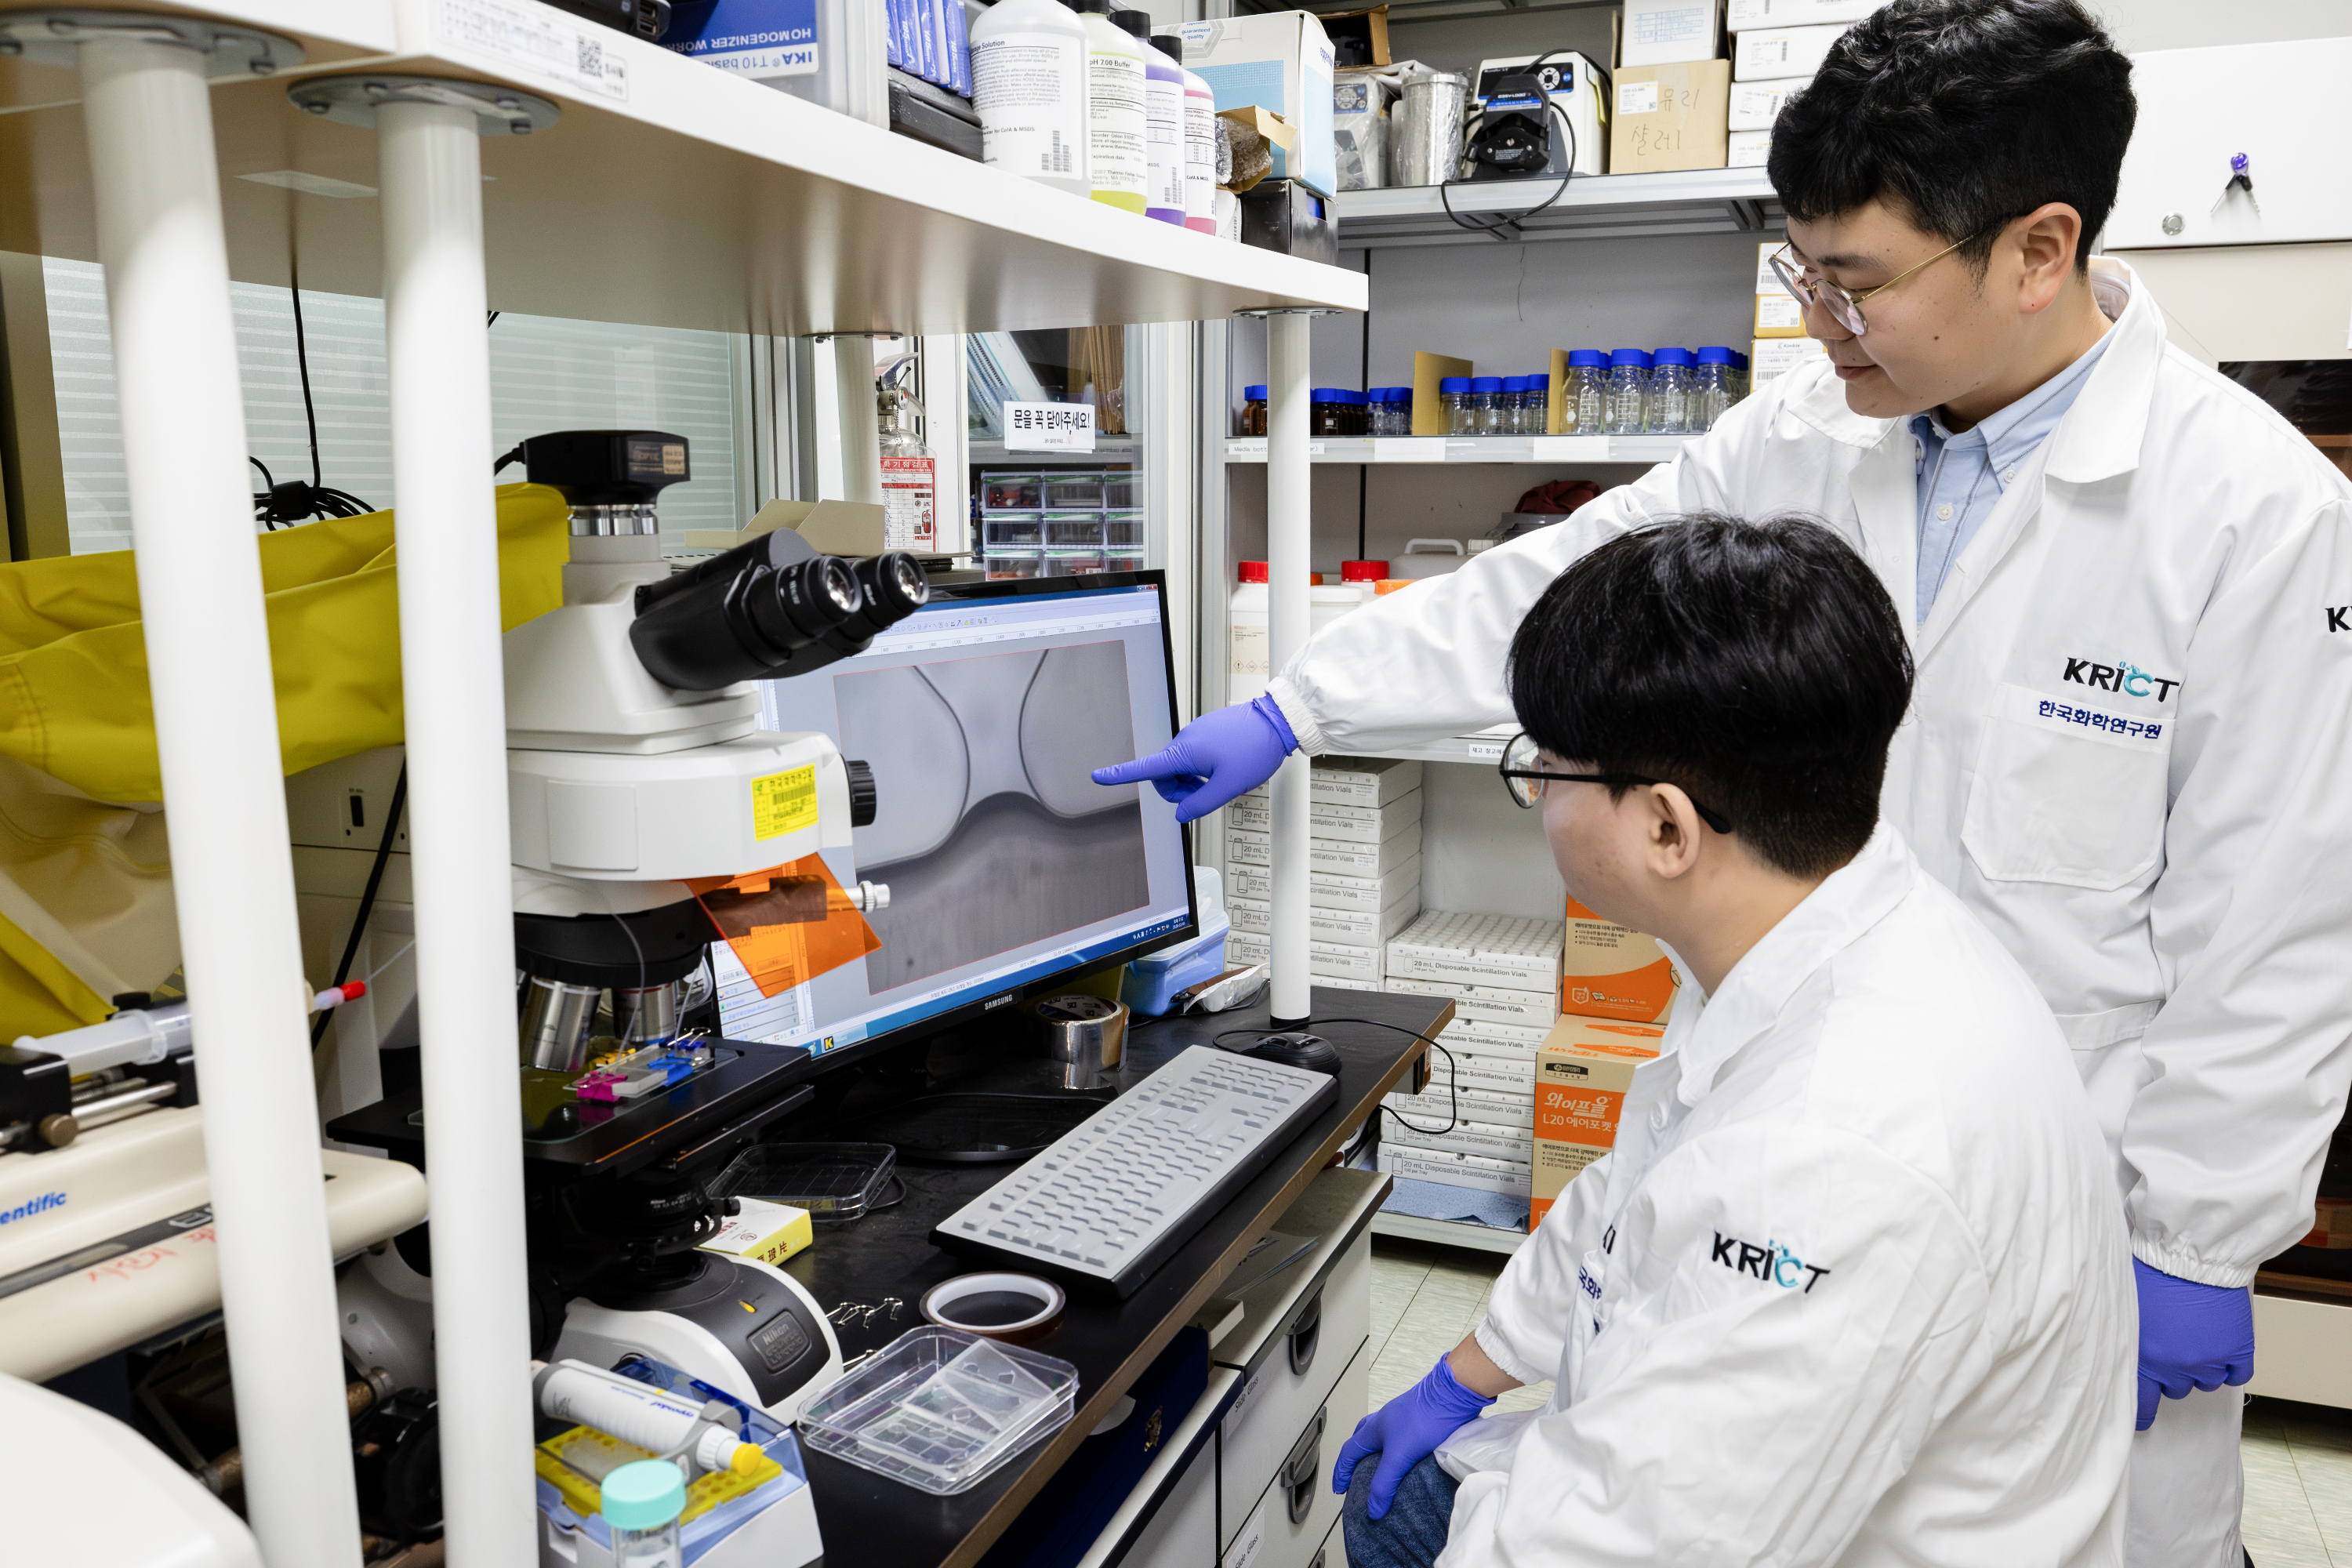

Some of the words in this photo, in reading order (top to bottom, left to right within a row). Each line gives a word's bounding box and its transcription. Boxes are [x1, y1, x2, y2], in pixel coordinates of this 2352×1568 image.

[711, 28, 811, 49] HOMOGENIZER
[982, 40, 1004, 49] Solution
[743, 56, 768, 69] T10
[1014, 410, 1032, 429] 문을
[1035, 411, 1044, 429] 꼭
[1047, 411, 1090, 430] 닫아주세요!
[2063, 657, 2180, 702] KRICT
[2038, 700, 2162, 739] 한국화학연구원
[1311, 887, 1341, 896] cintillation
[1436, 962, 1470, 973] Disposable
[1472, 967, 1509, 976] Scintillation
[985, 994, 1012, 1010] SAMSUNG
[1468, 1000, 1507, 1011] Scintillation
[825, 1036, 833, 1049] K
[1436, 1033, 1467, 1042] isposable
[1468, 1036, 1506, 1047] Scintillation
[1434, 1065, 1468, 1076] Dispoable
[1469, 1070, 1507, 1081] Scintillation
[1429, 1097, 1465, 1108] Disposble
[1465, 1102, 1503, 1112] Scintillation
[1544, 1092, 1609, 1115] 와이프올
[1544, 1113, 1564, 1126] L20
[1566, 1117, 1611, 1131] 에어포켓
[1466, 1136, 1502, 1147] Scintillation
[1504, 1141, 1521, 1149] Vials
[1425, 1163, 1460, 1175] Disposable
[1461, 1170, 1497, 1180] Scintillation
[0, 1192, 67, 1225] entific
[1711, 1230, 1830, 1294] KRICT
[763, 1323, 789, 1345] Nikon
[1234, 1393, 1246, 1413] Slide
[1247, 1376, 1259, 1396] Glass
[1247, 1534, 1258, 1555] Glass
